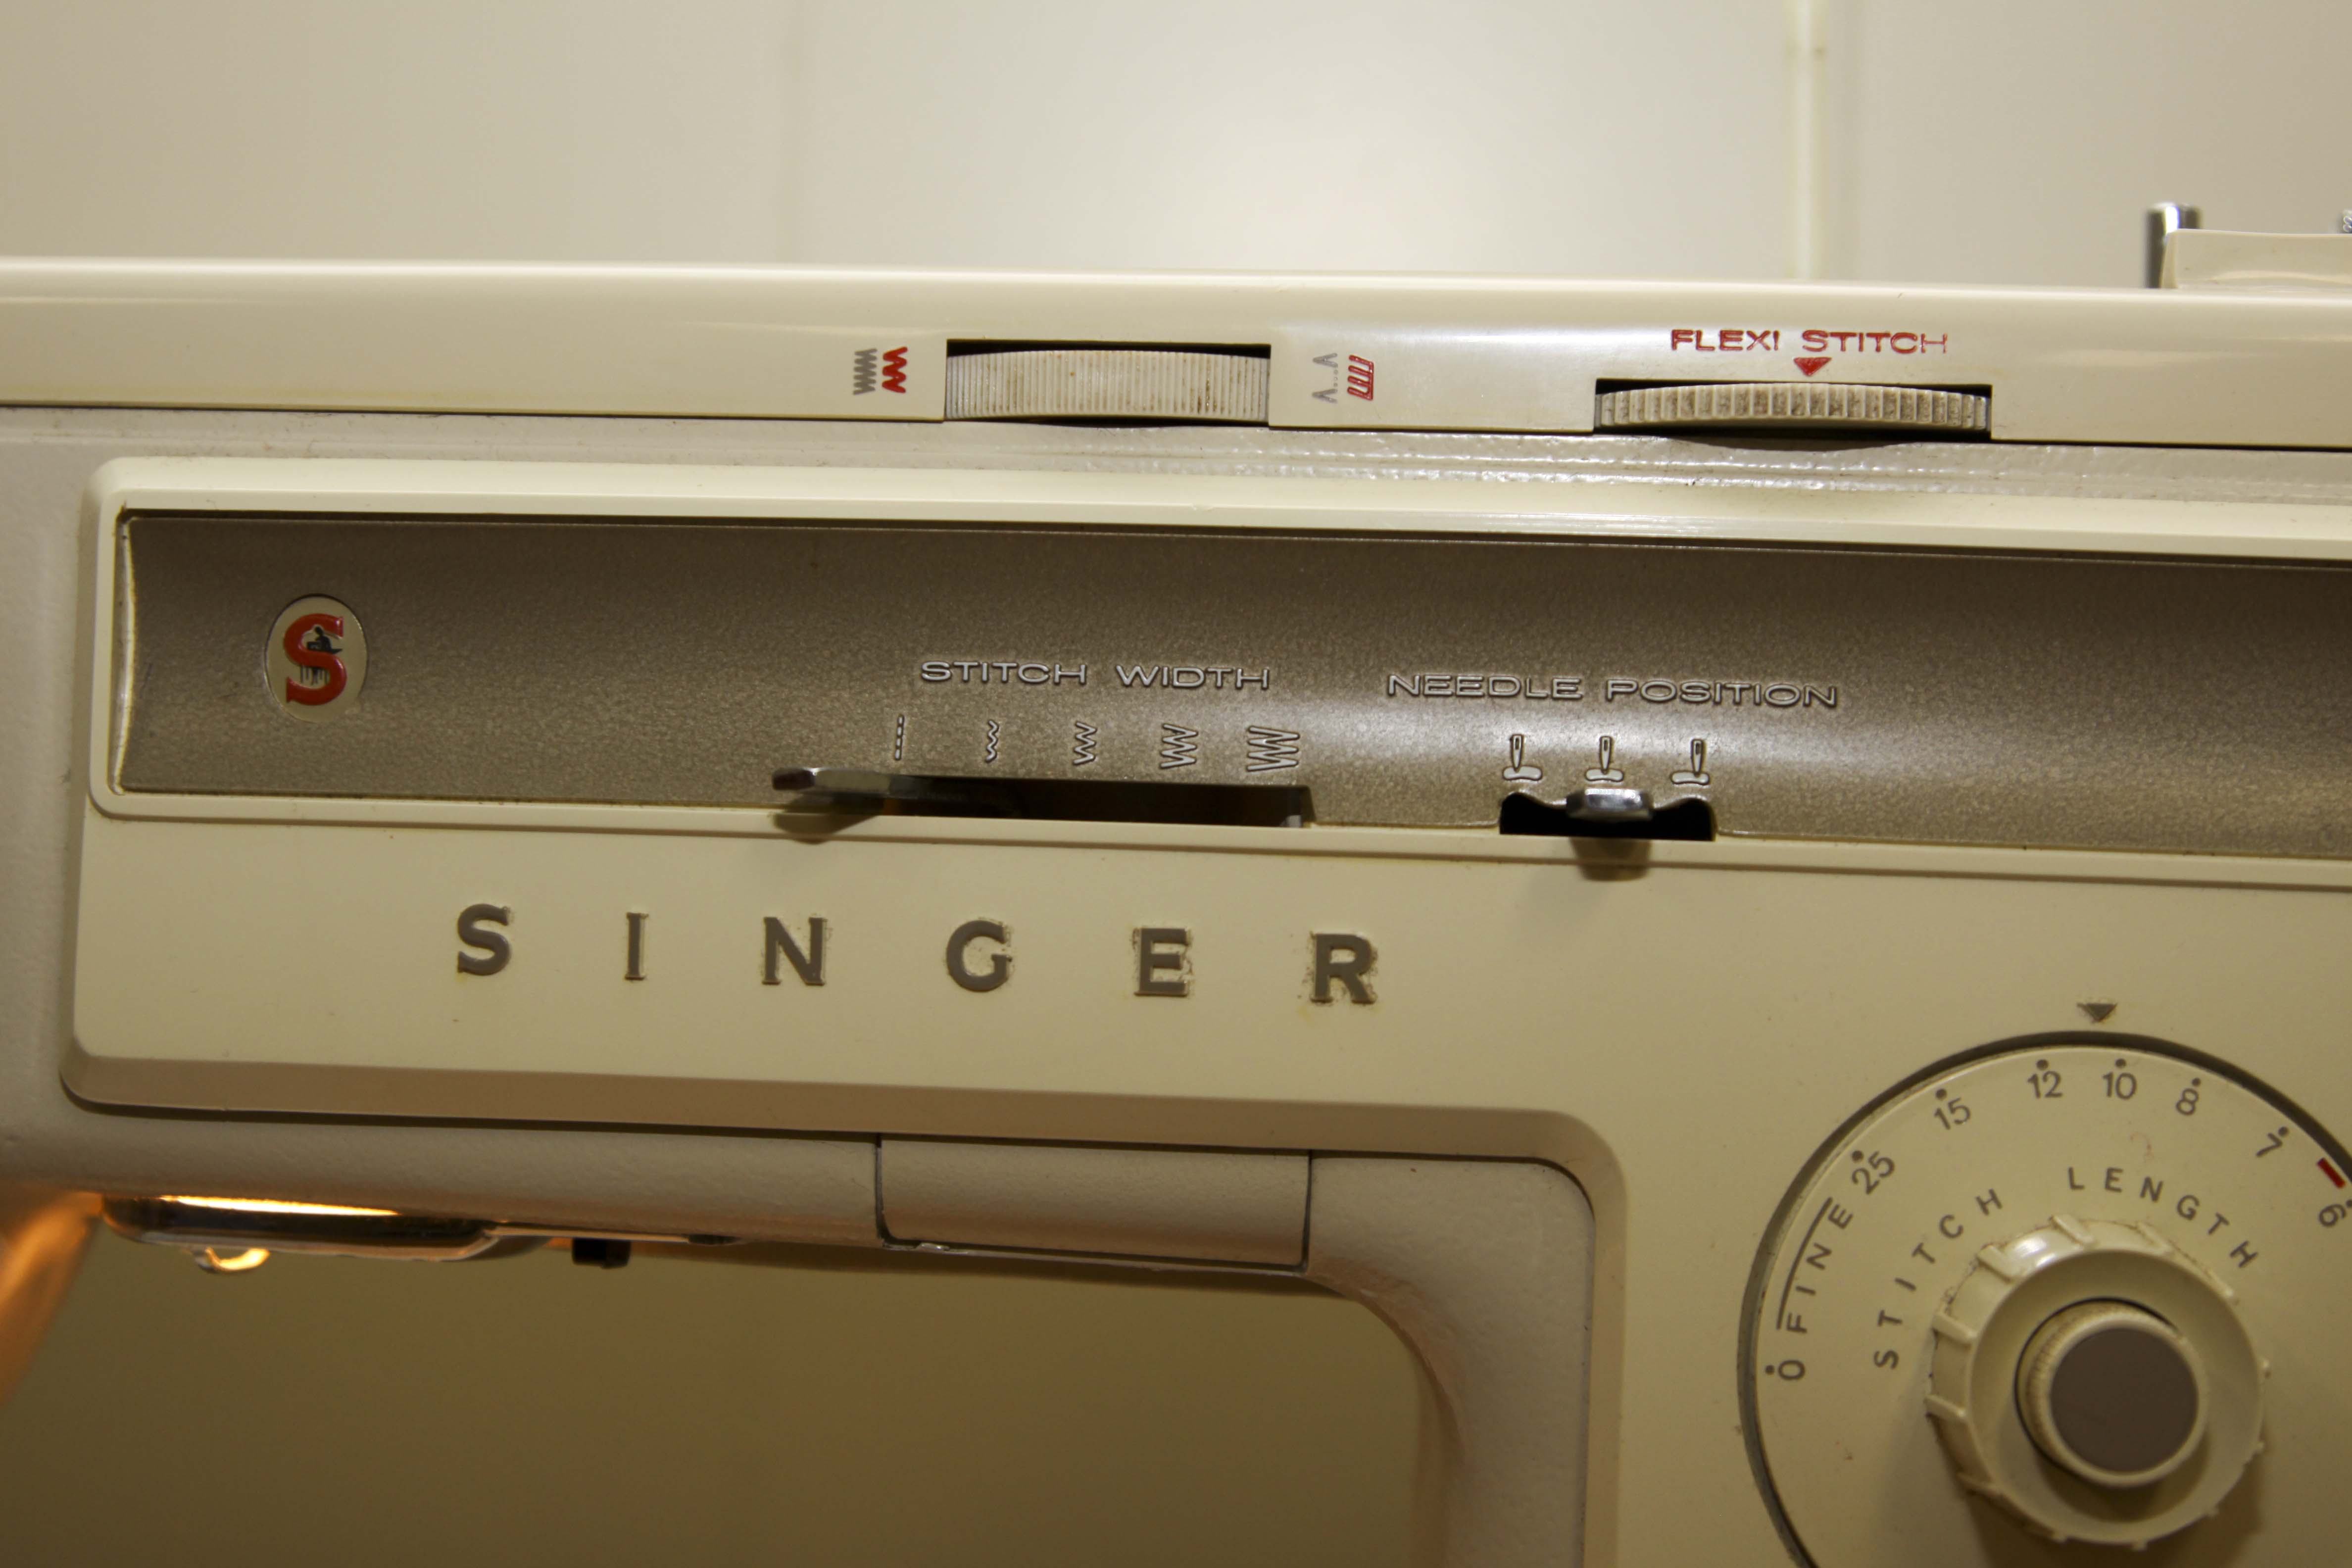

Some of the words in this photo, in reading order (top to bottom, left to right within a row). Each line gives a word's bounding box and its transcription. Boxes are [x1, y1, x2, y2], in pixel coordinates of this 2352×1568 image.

[1671, 329, 1780, 351] FLEXI
[1802, 329, 1948, 354] STITCH
[921, 661, 1087, 685] STITCH
[1115, 664, 1270, 689] WIDTH
[1387, 674, 1583, 699] NEEDLE
[1606, 678, 1837, 708] POSITION
[457, 903, 1378, 1004] SINGER
[2028, 1071, 2064, 1099] 12
[2103, 1071, 2138, 1100] 10
[1934, 1099, 1972, 1130] 15
[2175, 1088, 2200, 1117] 8
[2255, 1132, 2282, 1160] 7
[1851, 1152, 1896, 1194] 25
[1787, 1203, 1854, 1335] FINE
[1873, 1189, 2003, 1370] STITCH
[2068, 1166, 2258, 1268] LENGTH
